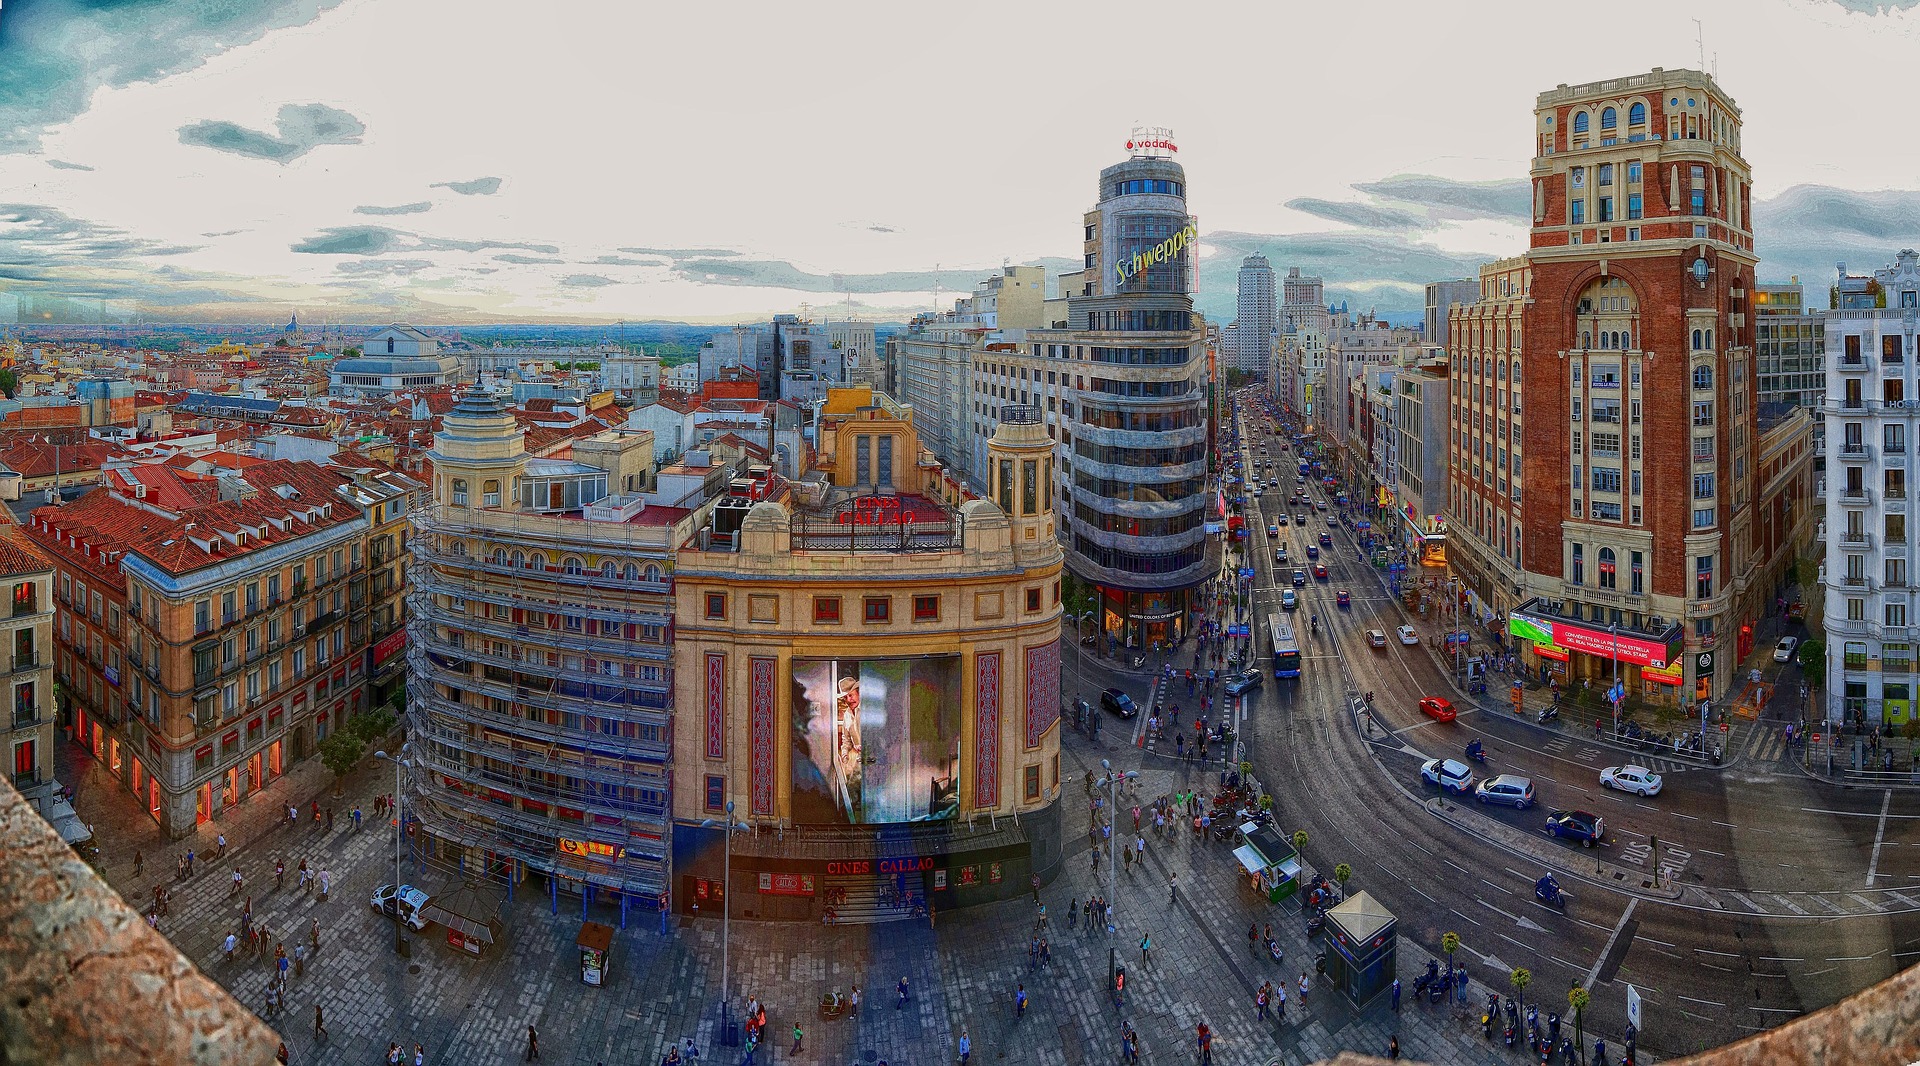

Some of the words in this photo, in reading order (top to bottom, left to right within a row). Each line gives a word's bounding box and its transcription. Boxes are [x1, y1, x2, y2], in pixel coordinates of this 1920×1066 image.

[1138, 139, 1178, 152] vodafone
[1116, 221, 1198, 286] Schweppes
[1889, 400, 1920, 409] HOST
[856, 496, 900, 508] CINES
[840, 510, 916, 525] CALLAO
[1166, 610, 1183, 618] BENETTON
[380, 638, 396, 649] LOCAL
[1565, 632, 1593, 642] CONVIÉRTETE
[1543, 737, 1572, 752] TAXI
[1575, 747, 1601, 761] BUS
[1620, 841, 1652, 865] BUS
[827, 862, 870, 874] CINES
[880, 858, 934, 873] CALLAO
[1657, 848, 1692, 878] SOLO
